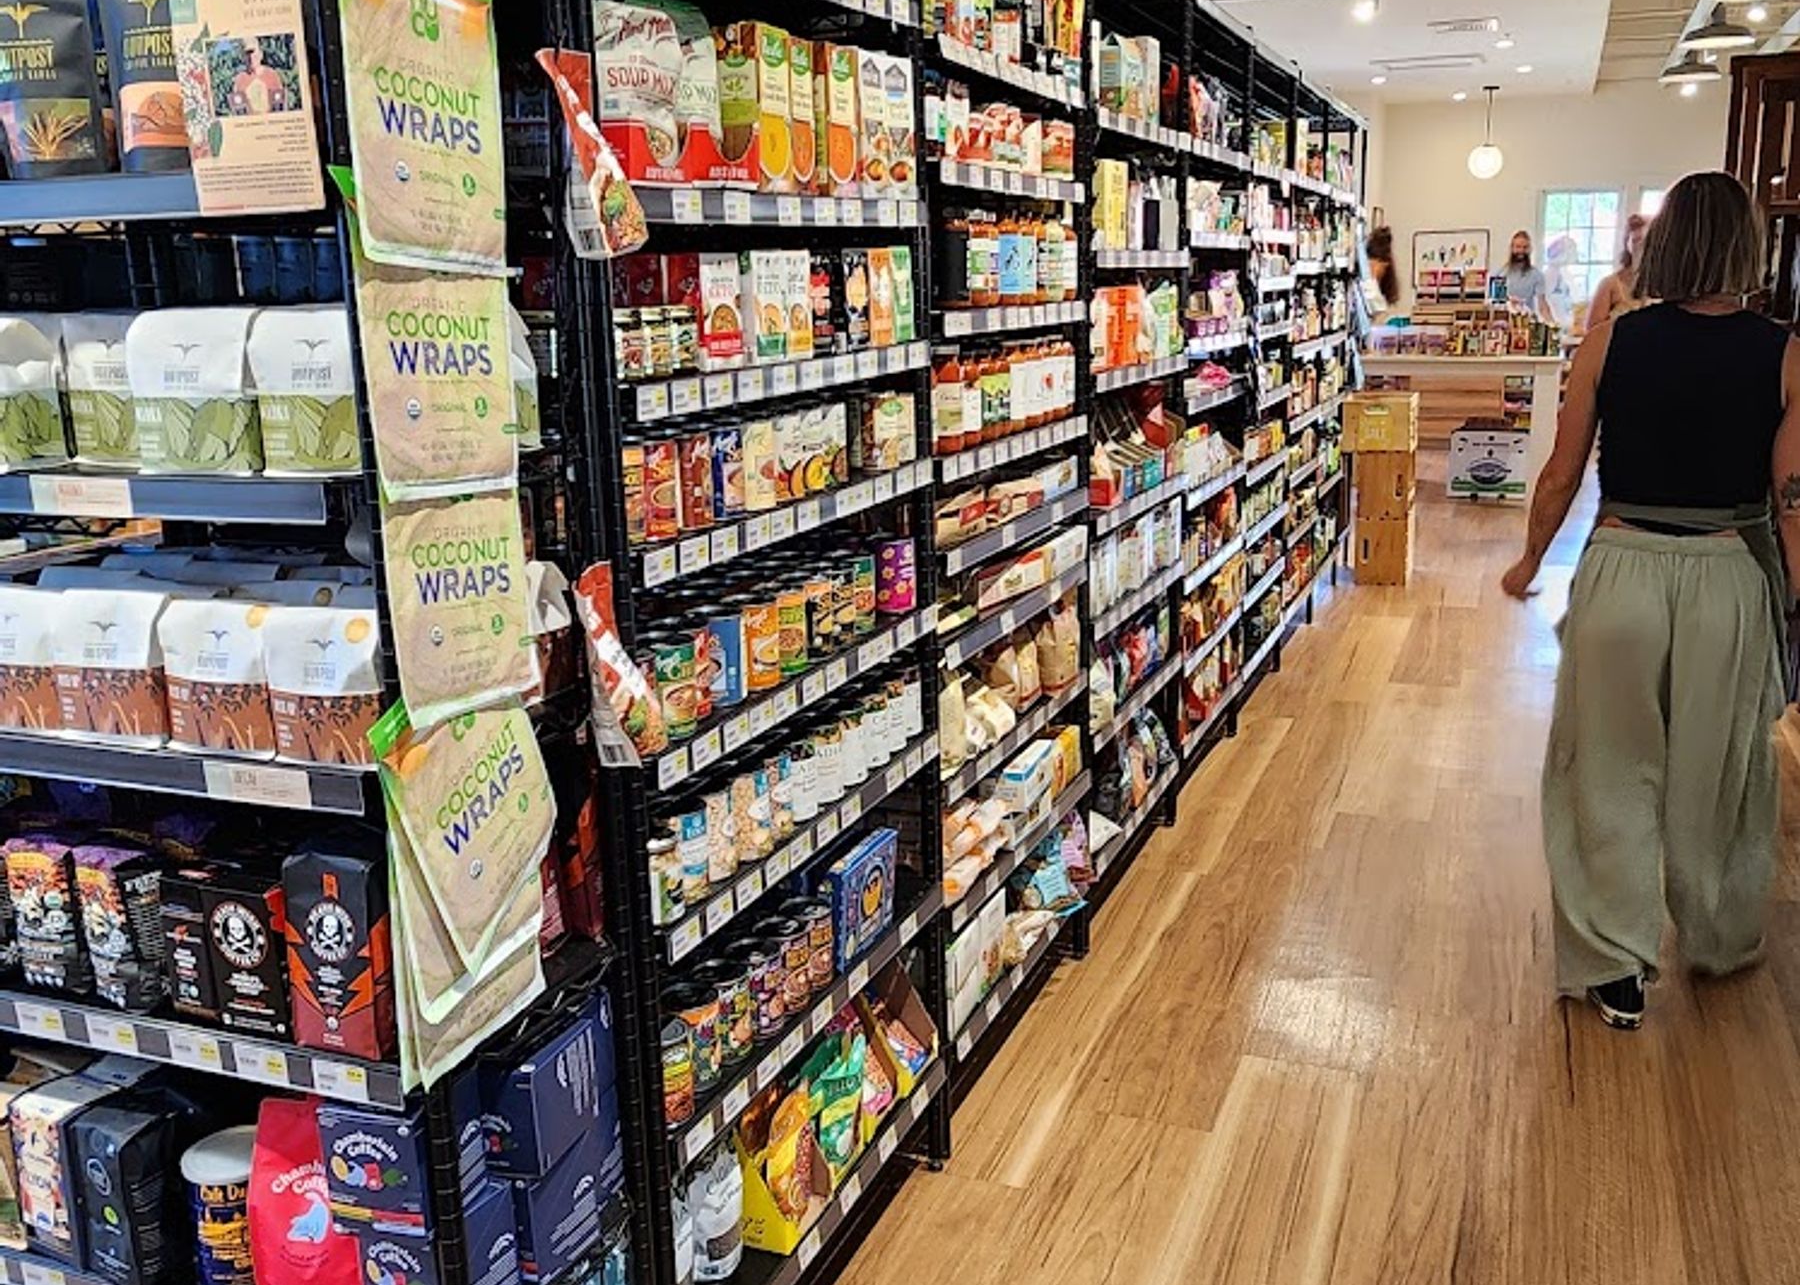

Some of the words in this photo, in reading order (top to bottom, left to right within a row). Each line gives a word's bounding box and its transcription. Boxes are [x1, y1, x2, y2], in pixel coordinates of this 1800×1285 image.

[122, 33, 172, 58] OUTPOS
[372, 66, 481, 118] COCONUT
[607, 66, 650, 89] SOUP
[376, 95, 482, 154] WRAPS
[386, 311, 490, 341] COCONUT
[388, 340, 494, 376] WRAPS
[411, 536, 511, 570] COCONUT
[414, 563, 512, 605] WRAPS
[435, 718, 517, 831] COCONUT
[443, 743, 525, 857] WRAPS
